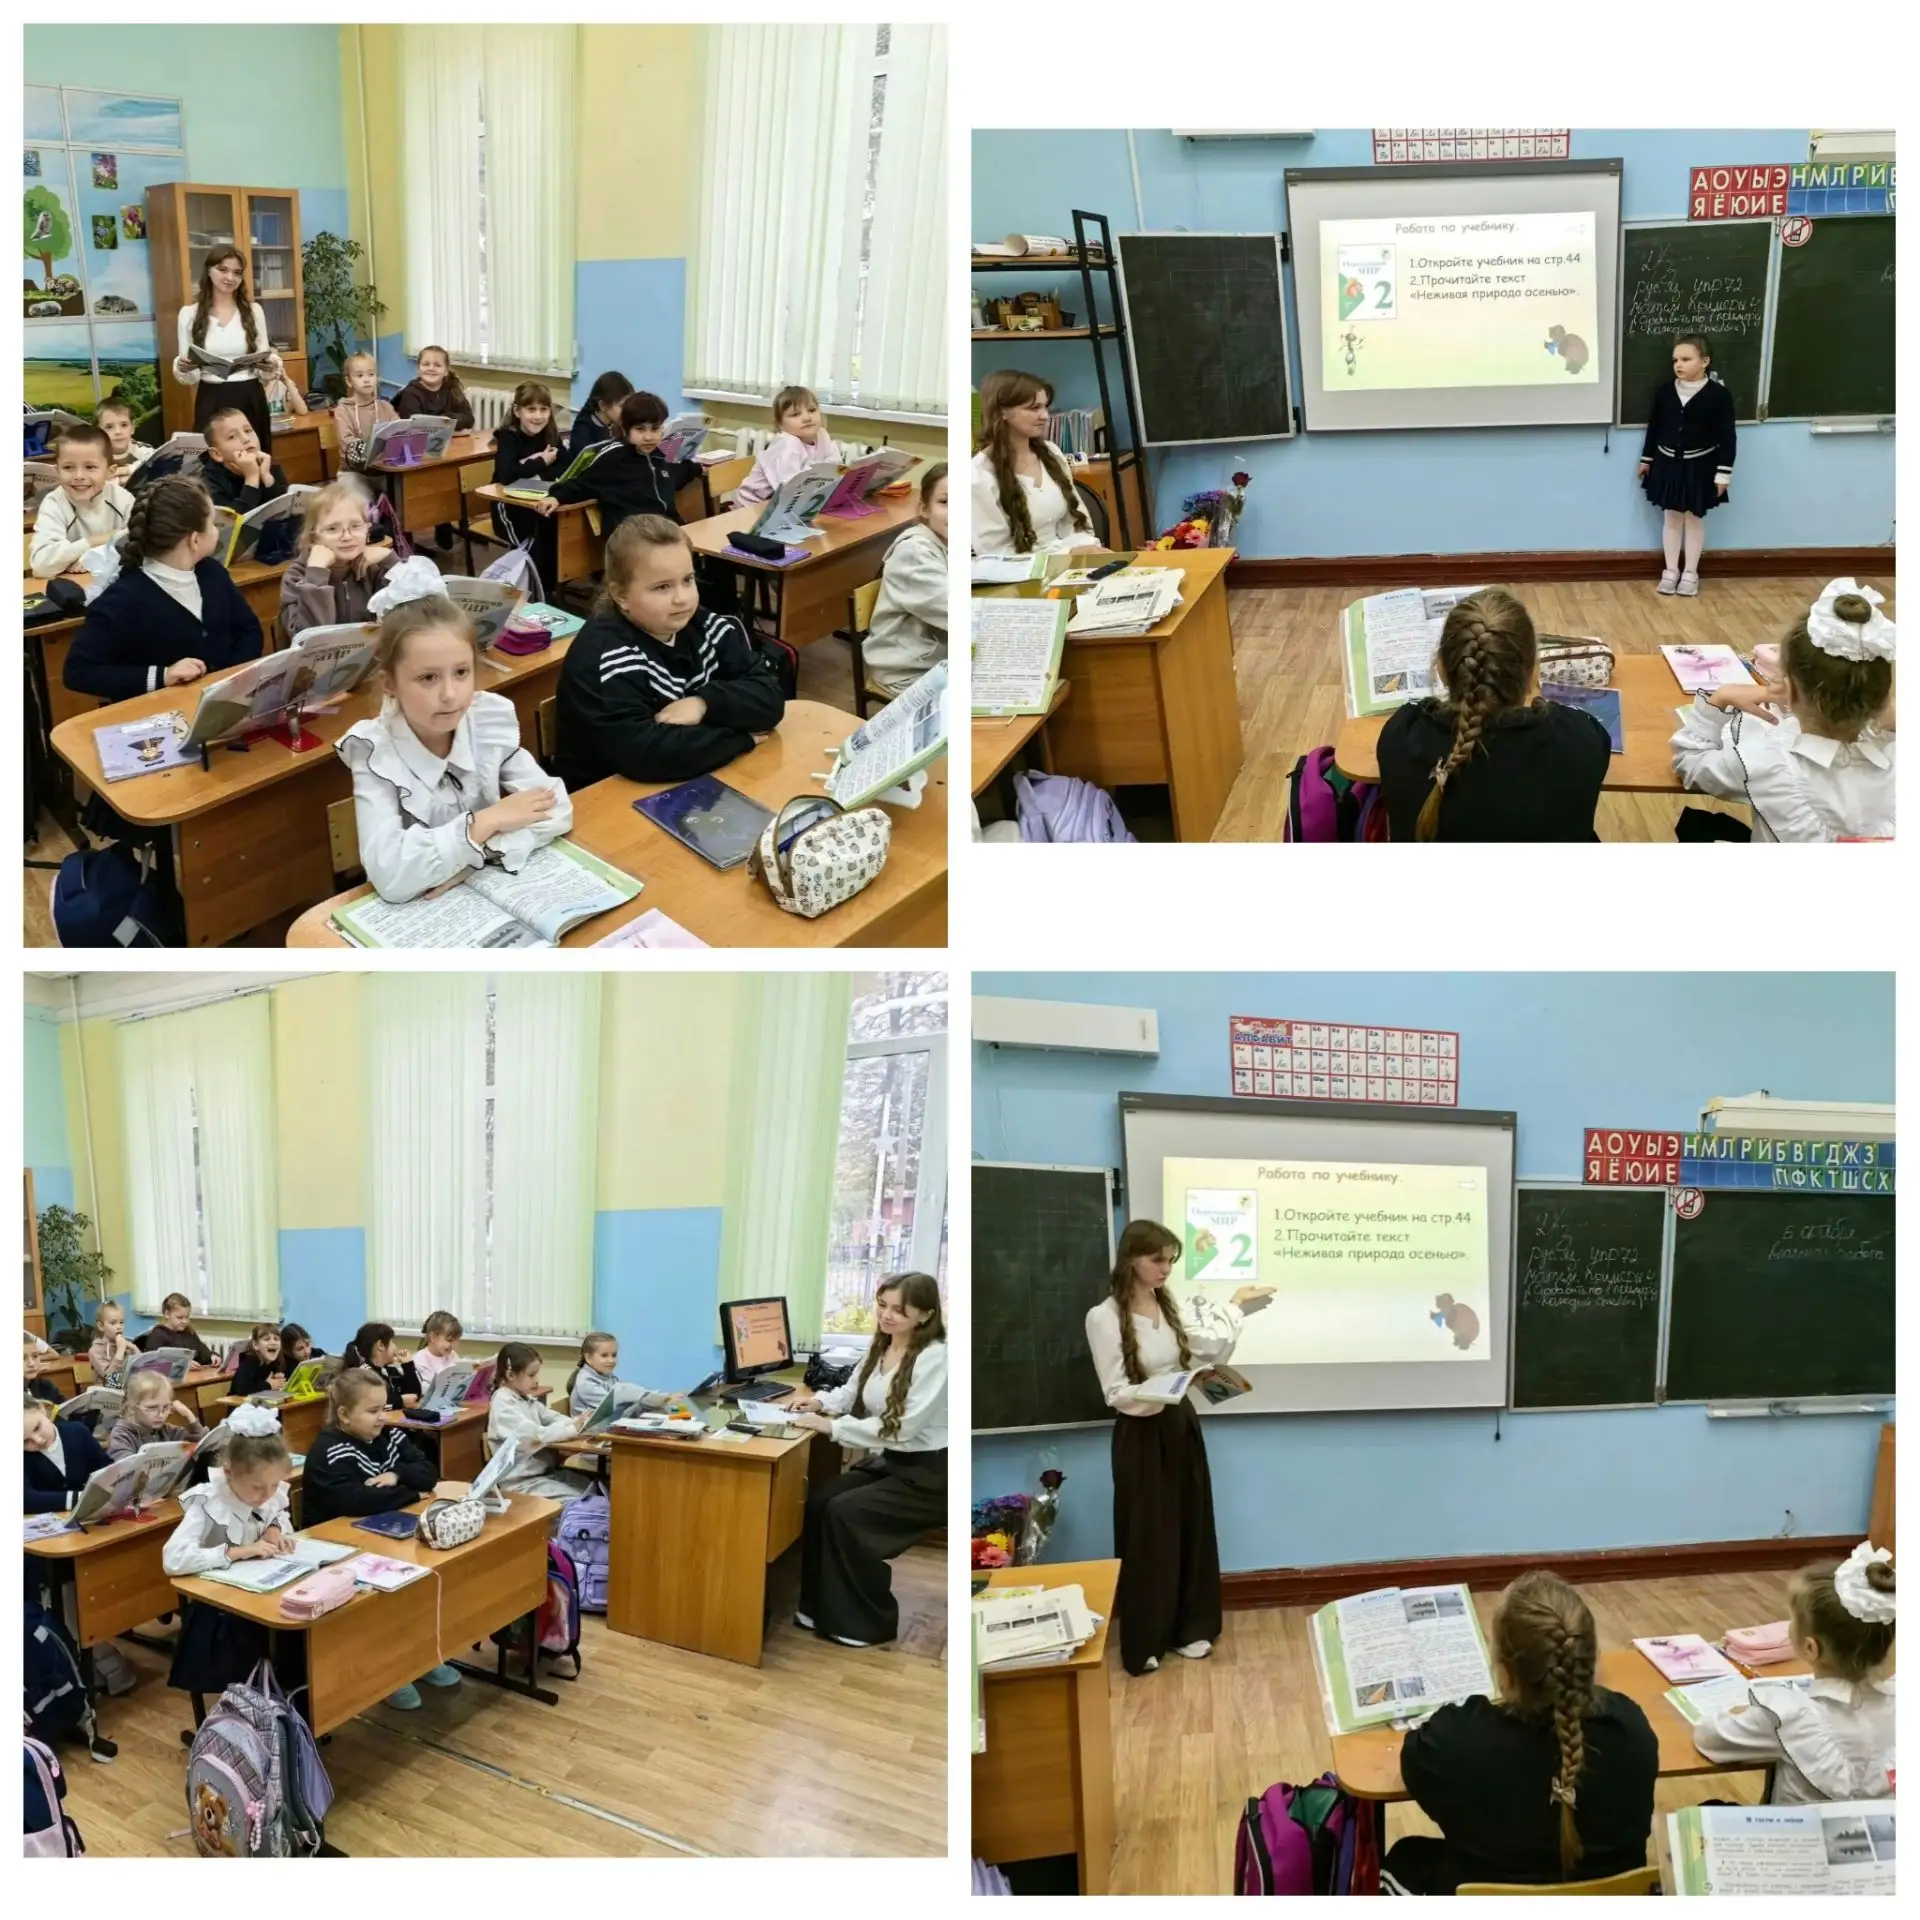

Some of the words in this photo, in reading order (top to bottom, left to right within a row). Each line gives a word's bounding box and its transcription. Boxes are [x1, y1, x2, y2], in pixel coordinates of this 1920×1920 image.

[1395, 223, 1435, 234] Работа
[1441, 224, 1456, 233] по
[1461, 221, 1520, 234] учебнику.
[1409, 256, 1473, 269] 1.Откройте
[1477, 256, 1524, 269] учебник
[1527, 257, 1541, 265] на
[1544, 253, 1581, 267] стр.44
[1496, 274, 1526, 284] текст
[1374, 280, 1393, 309] 2
[1410, 289, 1468, 300] «Неживая
[1472, 288, 1521, 300] природа
[1258, 1167, 1305, 1181] Работа
[1312, 1171, 1330, 1181] по
[1336, 1171, 1402, 1185] учебнику.
[1273, 1208, 1349, 1223] 1.Откройте
[1354, 1209, 1407, 1225] учебник
[1412, 1213, 1428, 1223] на
[1431, 1211, 1472, 1227] стр.44
[1376, 1232, 1410, 1243] текст
[1230, 1233, 1253, 1268] 2
[1273, 1247, 1343, 1260] «Неживая
[1348, 1249, 1405, 1263] природа
